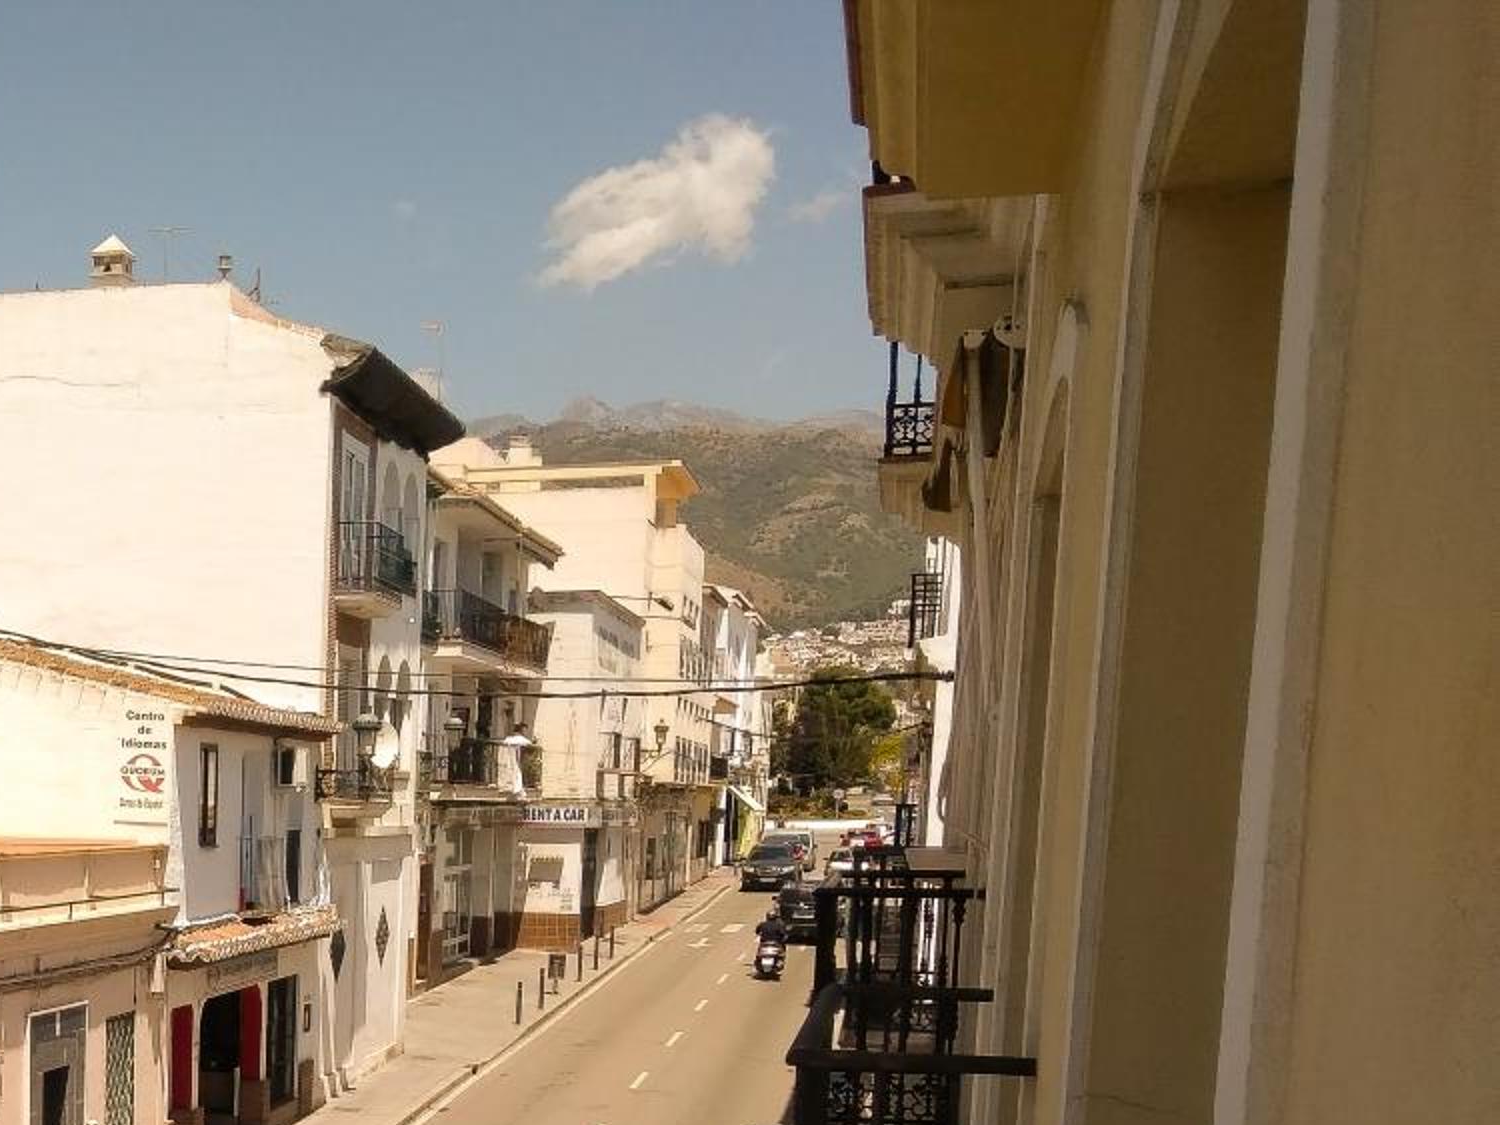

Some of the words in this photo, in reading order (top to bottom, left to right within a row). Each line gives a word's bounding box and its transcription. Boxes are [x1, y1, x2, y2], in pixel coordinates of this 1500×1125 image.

[125, 709, 165, 721] Centro
[137, 725, 153, 735] de
[121, 737, 167, 750] Idiomas
[523, 808, 551, 821] RENT
[553, 808, 561, 821] A
[563, 808, 585, 821] CAR
